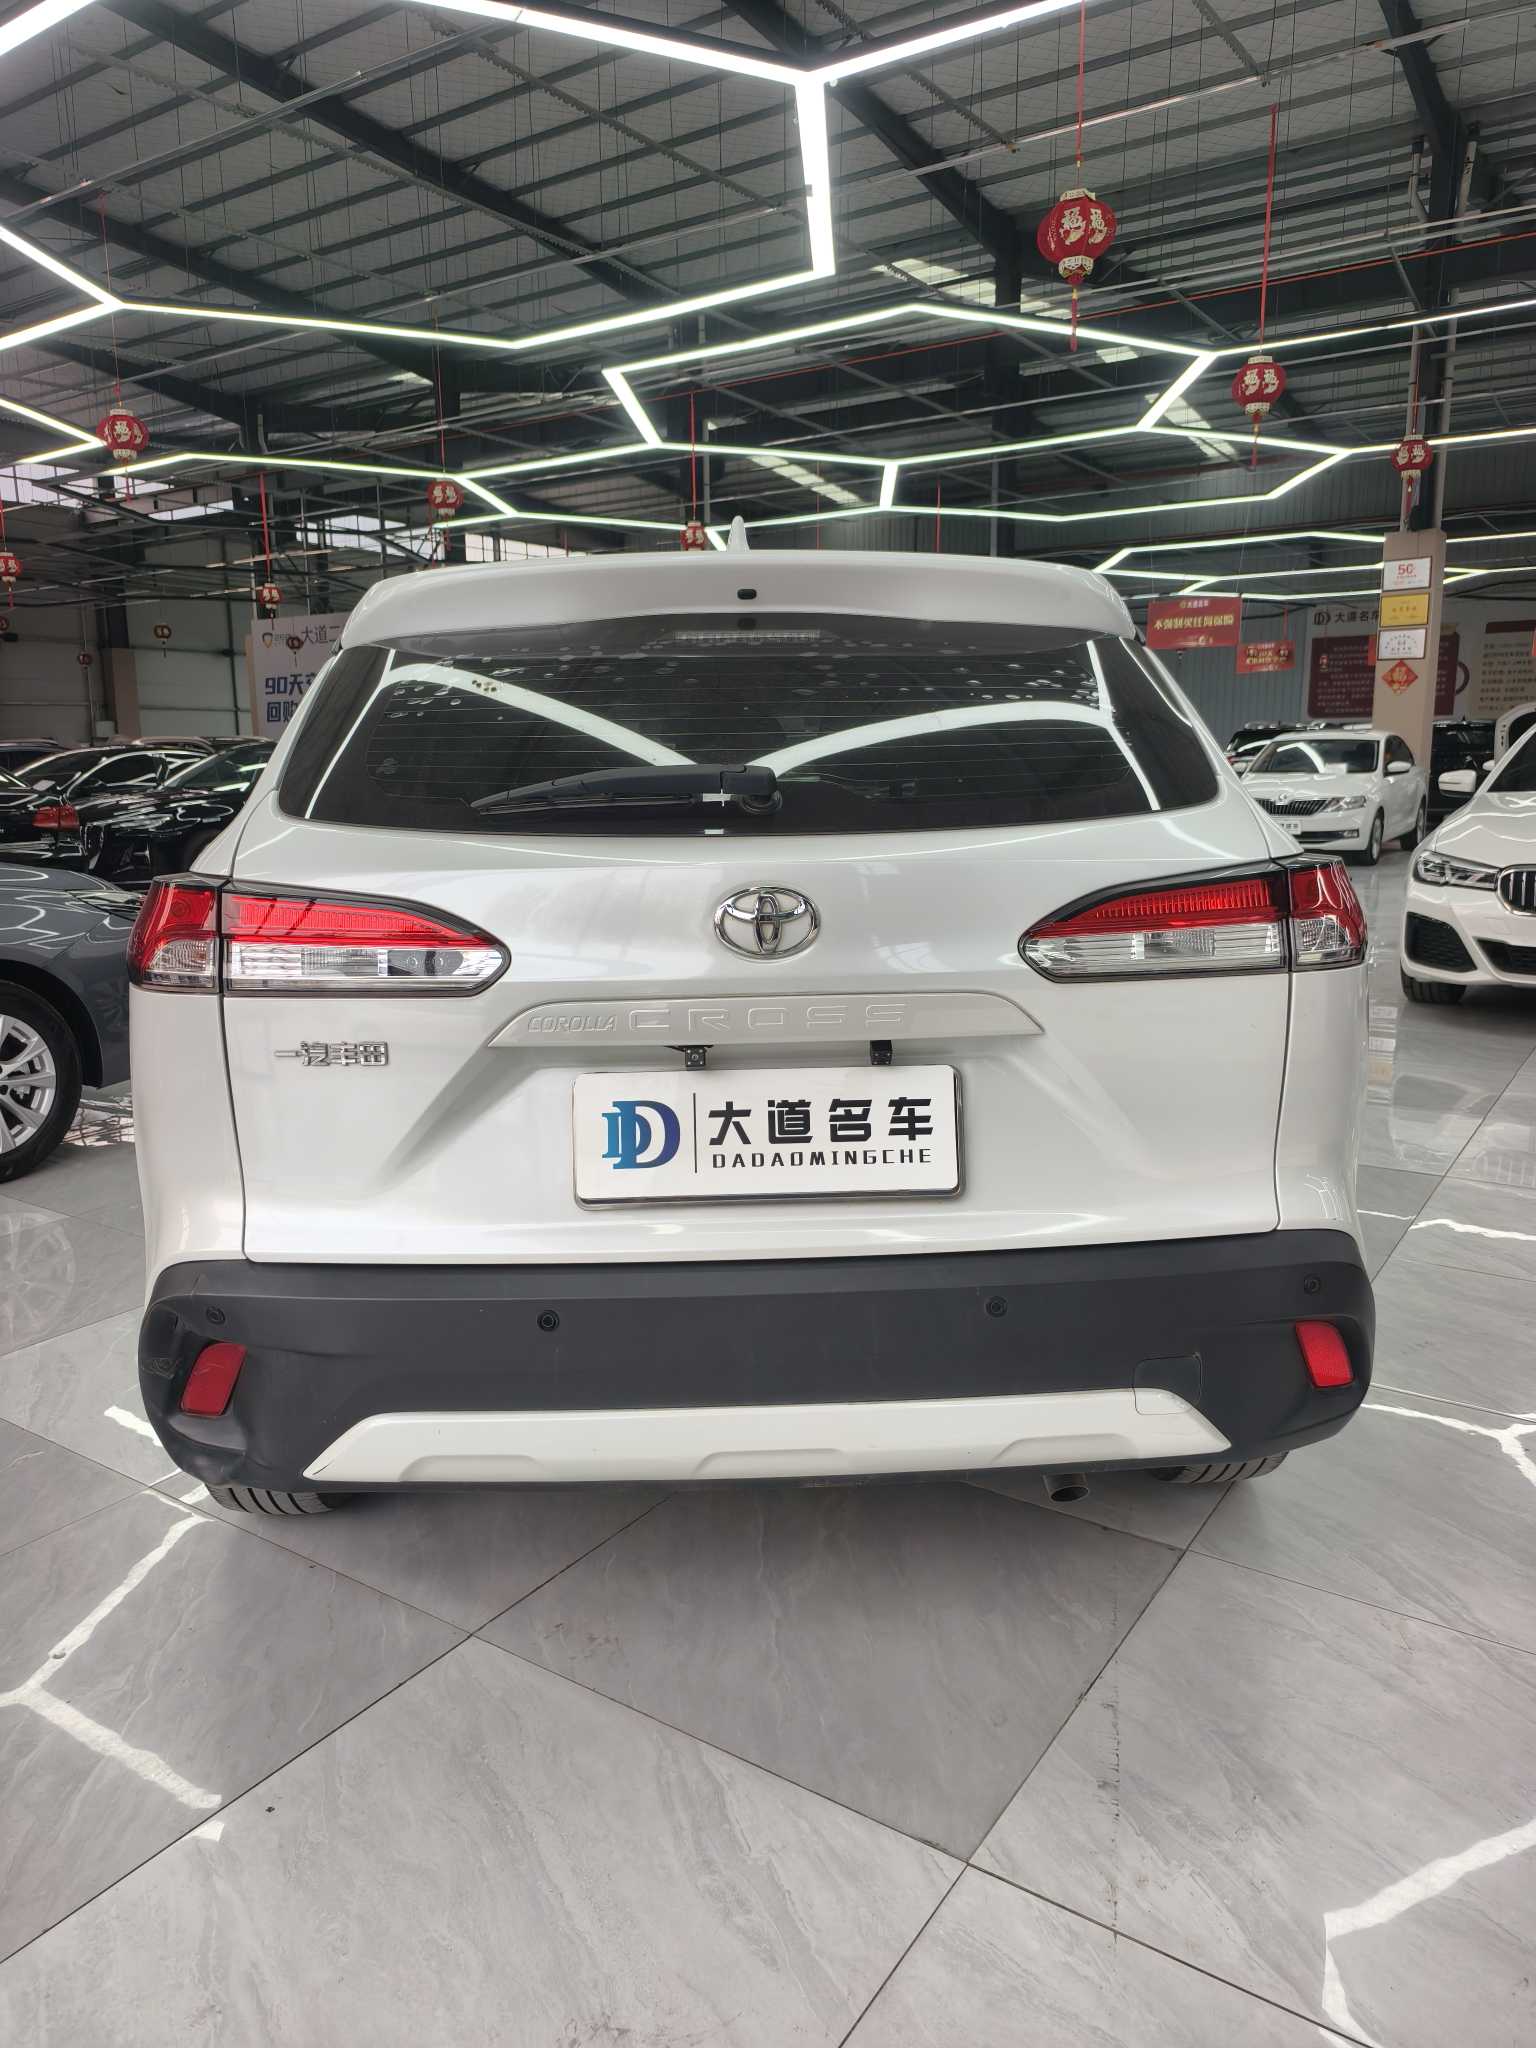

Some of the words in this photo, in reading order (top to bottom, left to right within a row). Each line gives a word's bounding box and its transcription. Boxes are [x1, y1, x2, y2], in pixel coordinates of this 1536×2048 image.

[527, 1015, 617, 1034] COROLLA
[629, 1003, 905, 1032] CROSS
[273, 1041, 389, 1067] 一汽丰田
[708, 1097, 934, 1146] 大道名车
[712, 1148, 932, 1169] DADAOMINGCHE
